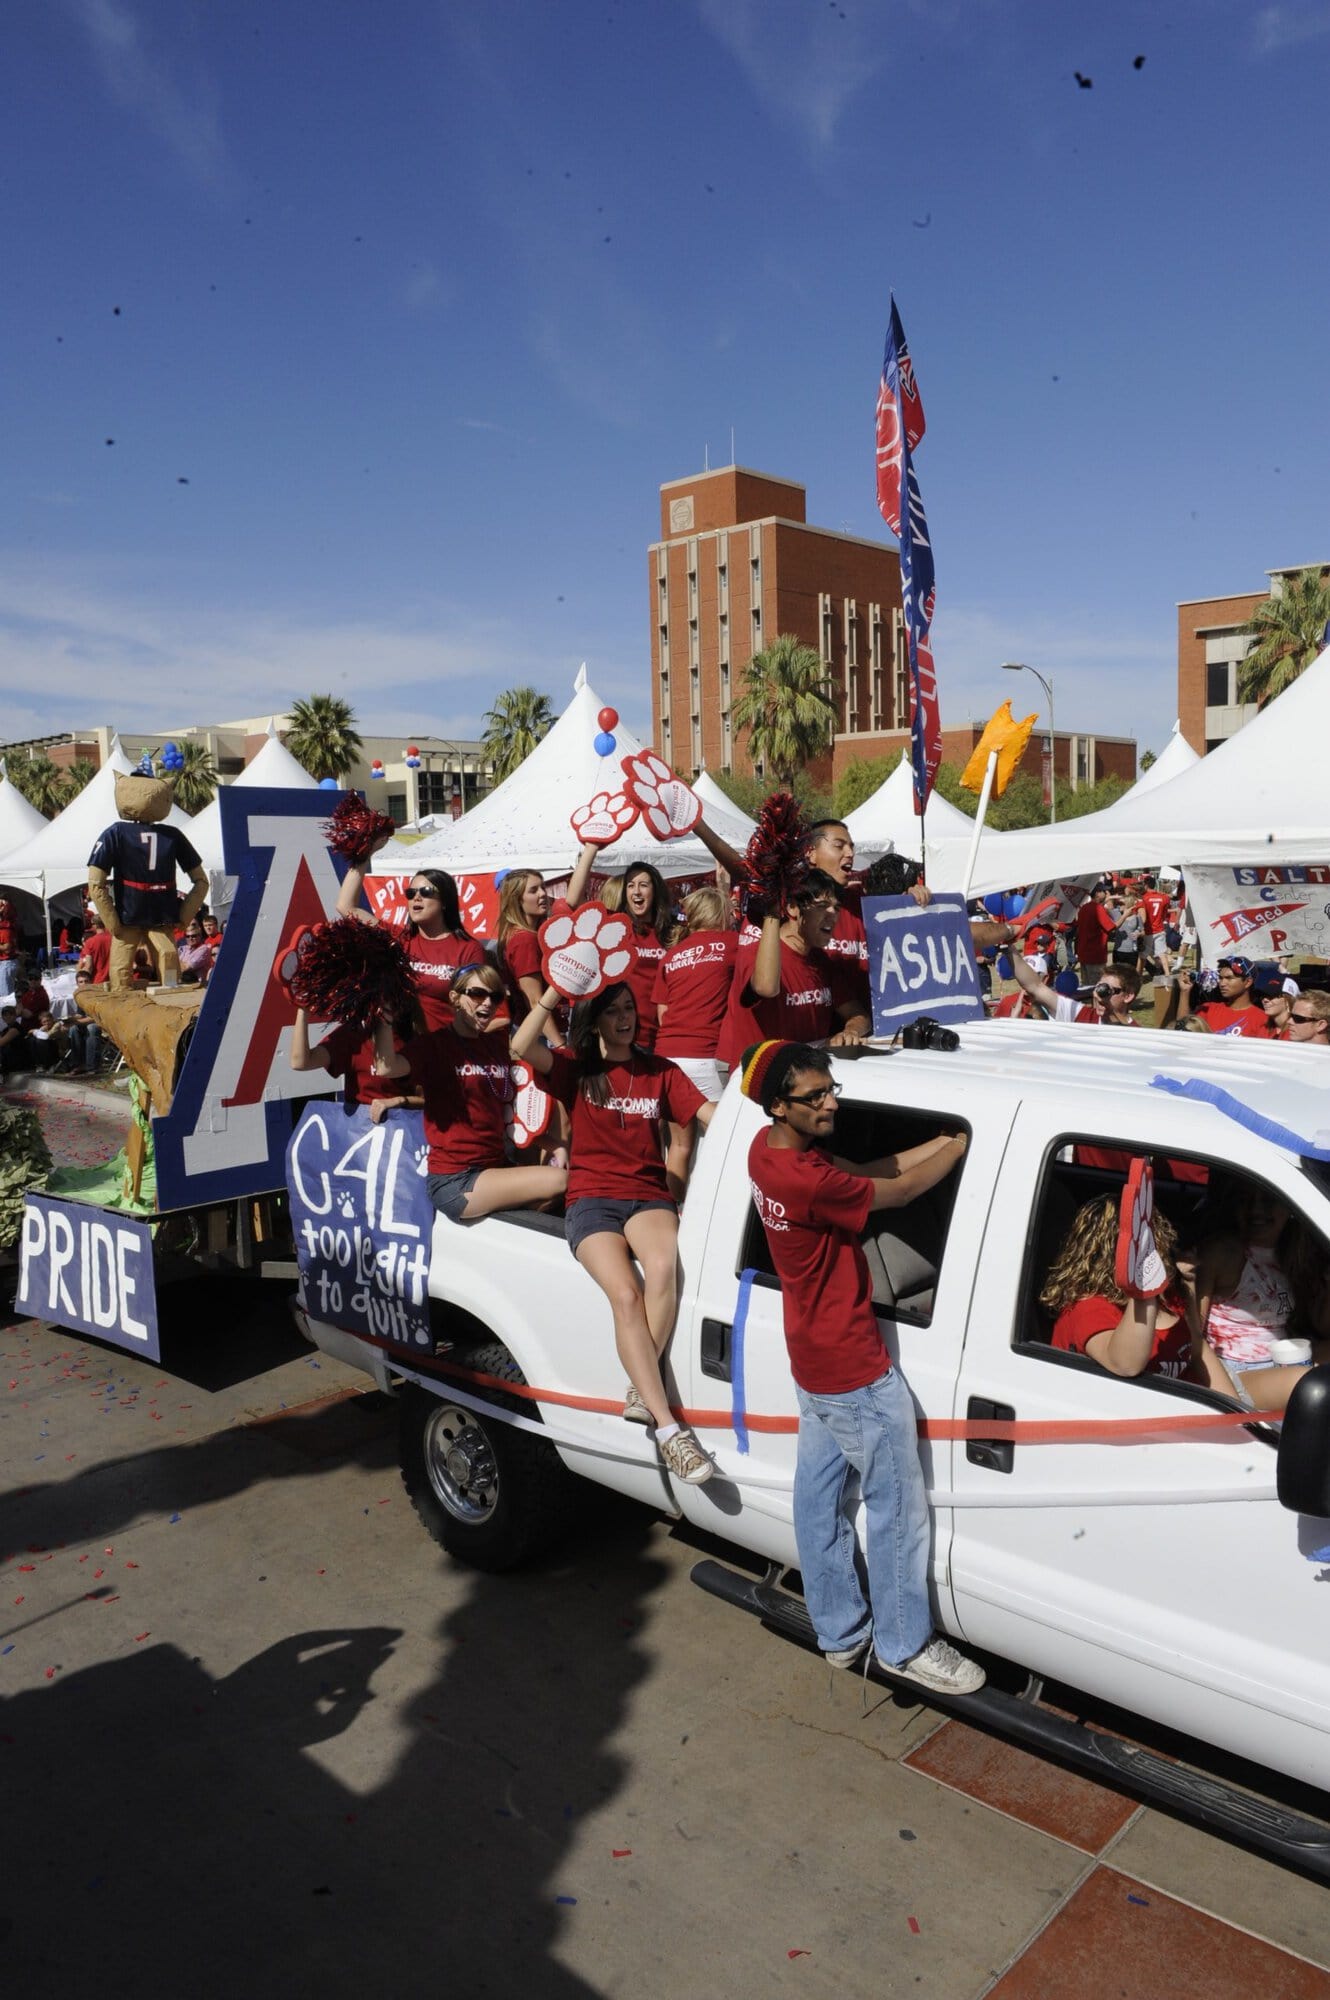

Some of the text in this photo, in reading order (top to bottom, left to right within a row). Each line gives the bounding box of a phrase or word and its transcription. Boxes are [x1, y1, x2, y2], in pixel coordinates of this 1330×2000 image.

[93, 841, 103, 855] 7
[140, 832, 157, 870] 7
[1239, 867, 1326, 885] SALT
[1260, 886, 1317, 902] Center
[1152, 902, 1160, 917] 7
[1232, 905, 1284, 937] Aged
[1303, 911, 1324, 931] to
[709, 942, 725, 952] TO
[553, 961, 591, 986] crossing
[558, 952, 593, 976] campus
[880, 933, 975, 993] ASUA
[291, 1114, 420, 1238] CAL
[765, 1197, 786, 1218] TO
[20, 1205, 148, 1341] PRIDE
[302, 1219, 428, 1306] too legit
[317, 1269, 409, 1344] to quit
